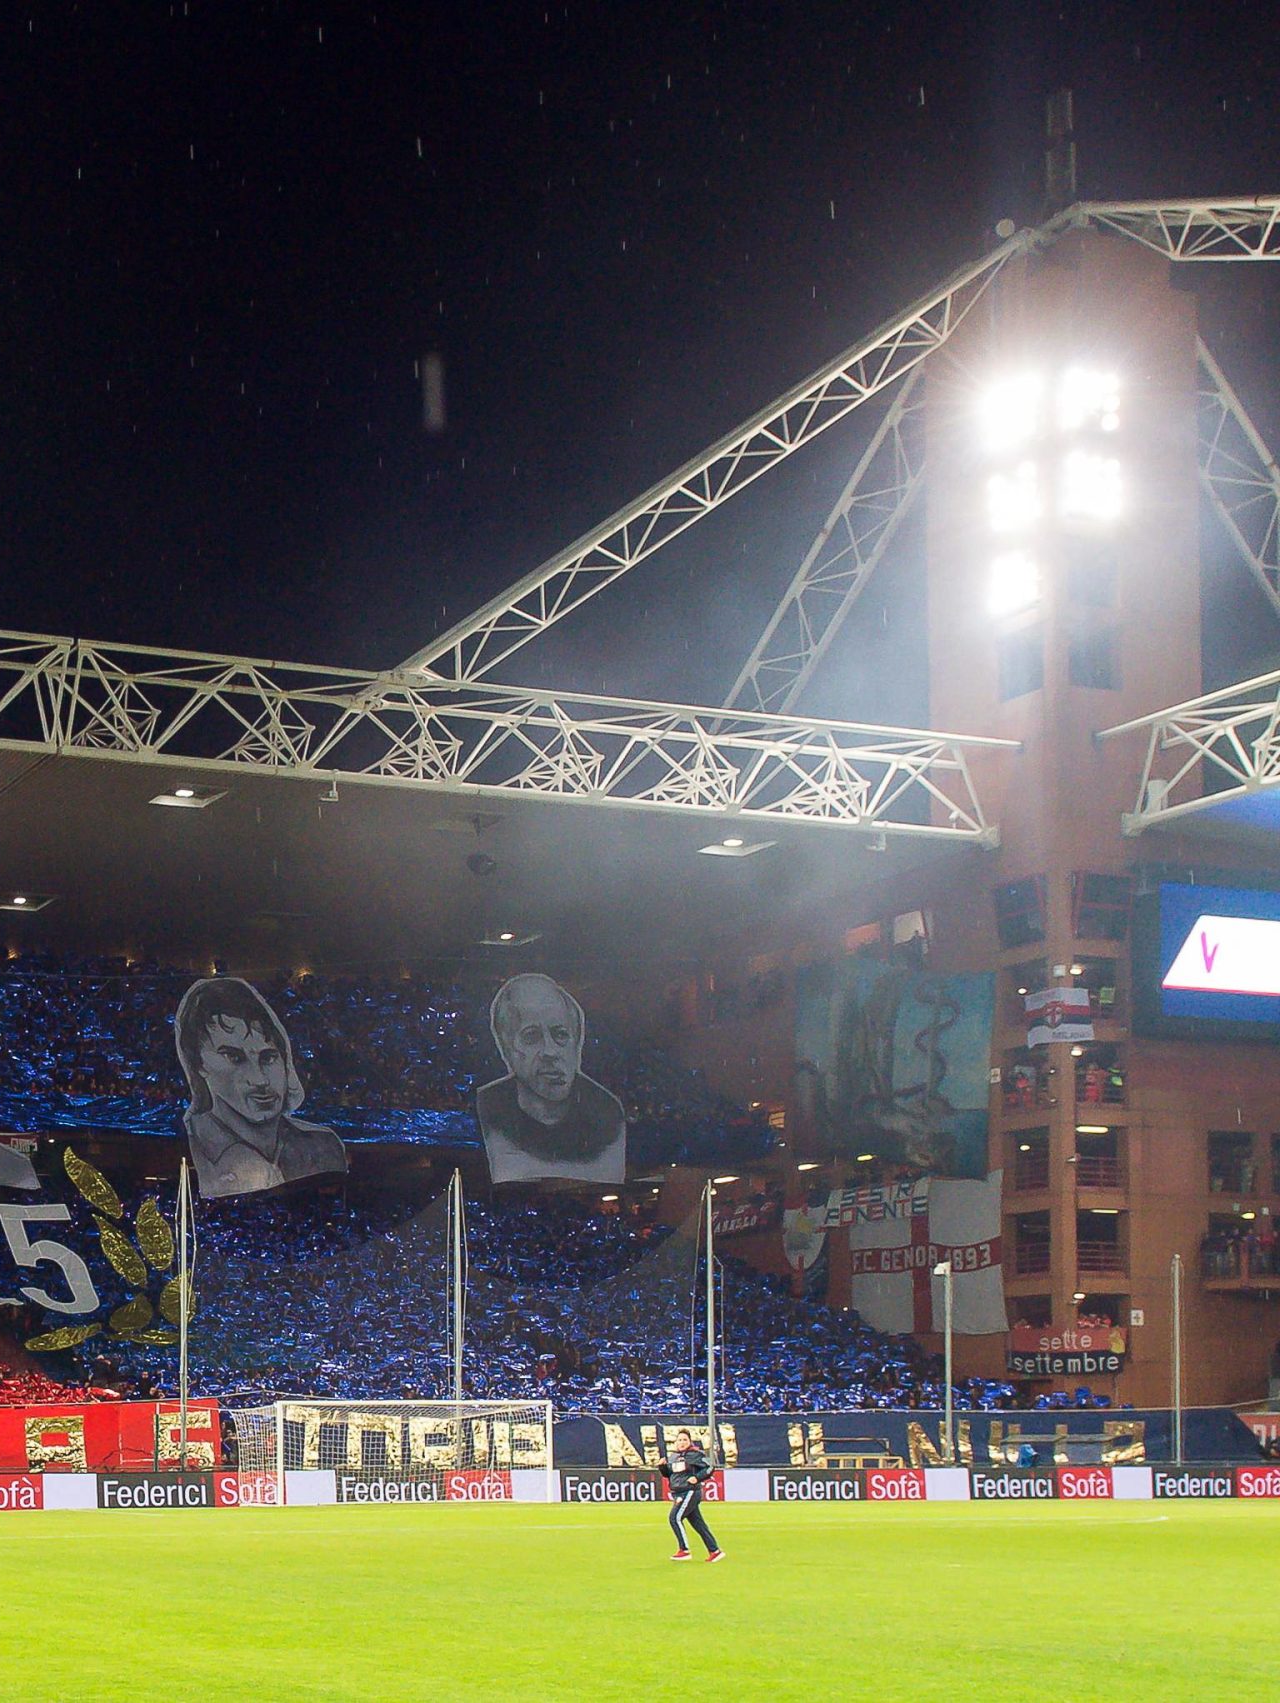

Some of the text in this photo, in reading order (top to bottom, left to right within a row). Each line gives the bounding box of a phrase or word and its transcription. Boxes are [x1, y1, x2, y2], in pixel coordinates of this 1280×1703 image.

[824, 1196, 929, 1225] PONENTE
[881, 1246, 938, 1272] GENOA
[1040, 1329, 1092, 1351] sette
[1013, 1352, 1120, 1374] settembre
[103, 1471, 277, 1507] Federici Sofà
[341, 1471, 506, 1502] Federici Sofà
[564, 1474, 656, 1501] Federici
[773, 1471, 921, 1500] Federici Sofà
[972, 1470, 1109, 1498] Federici Sofà
[1155, 1469, 1280, 1497] Federici Sofà
